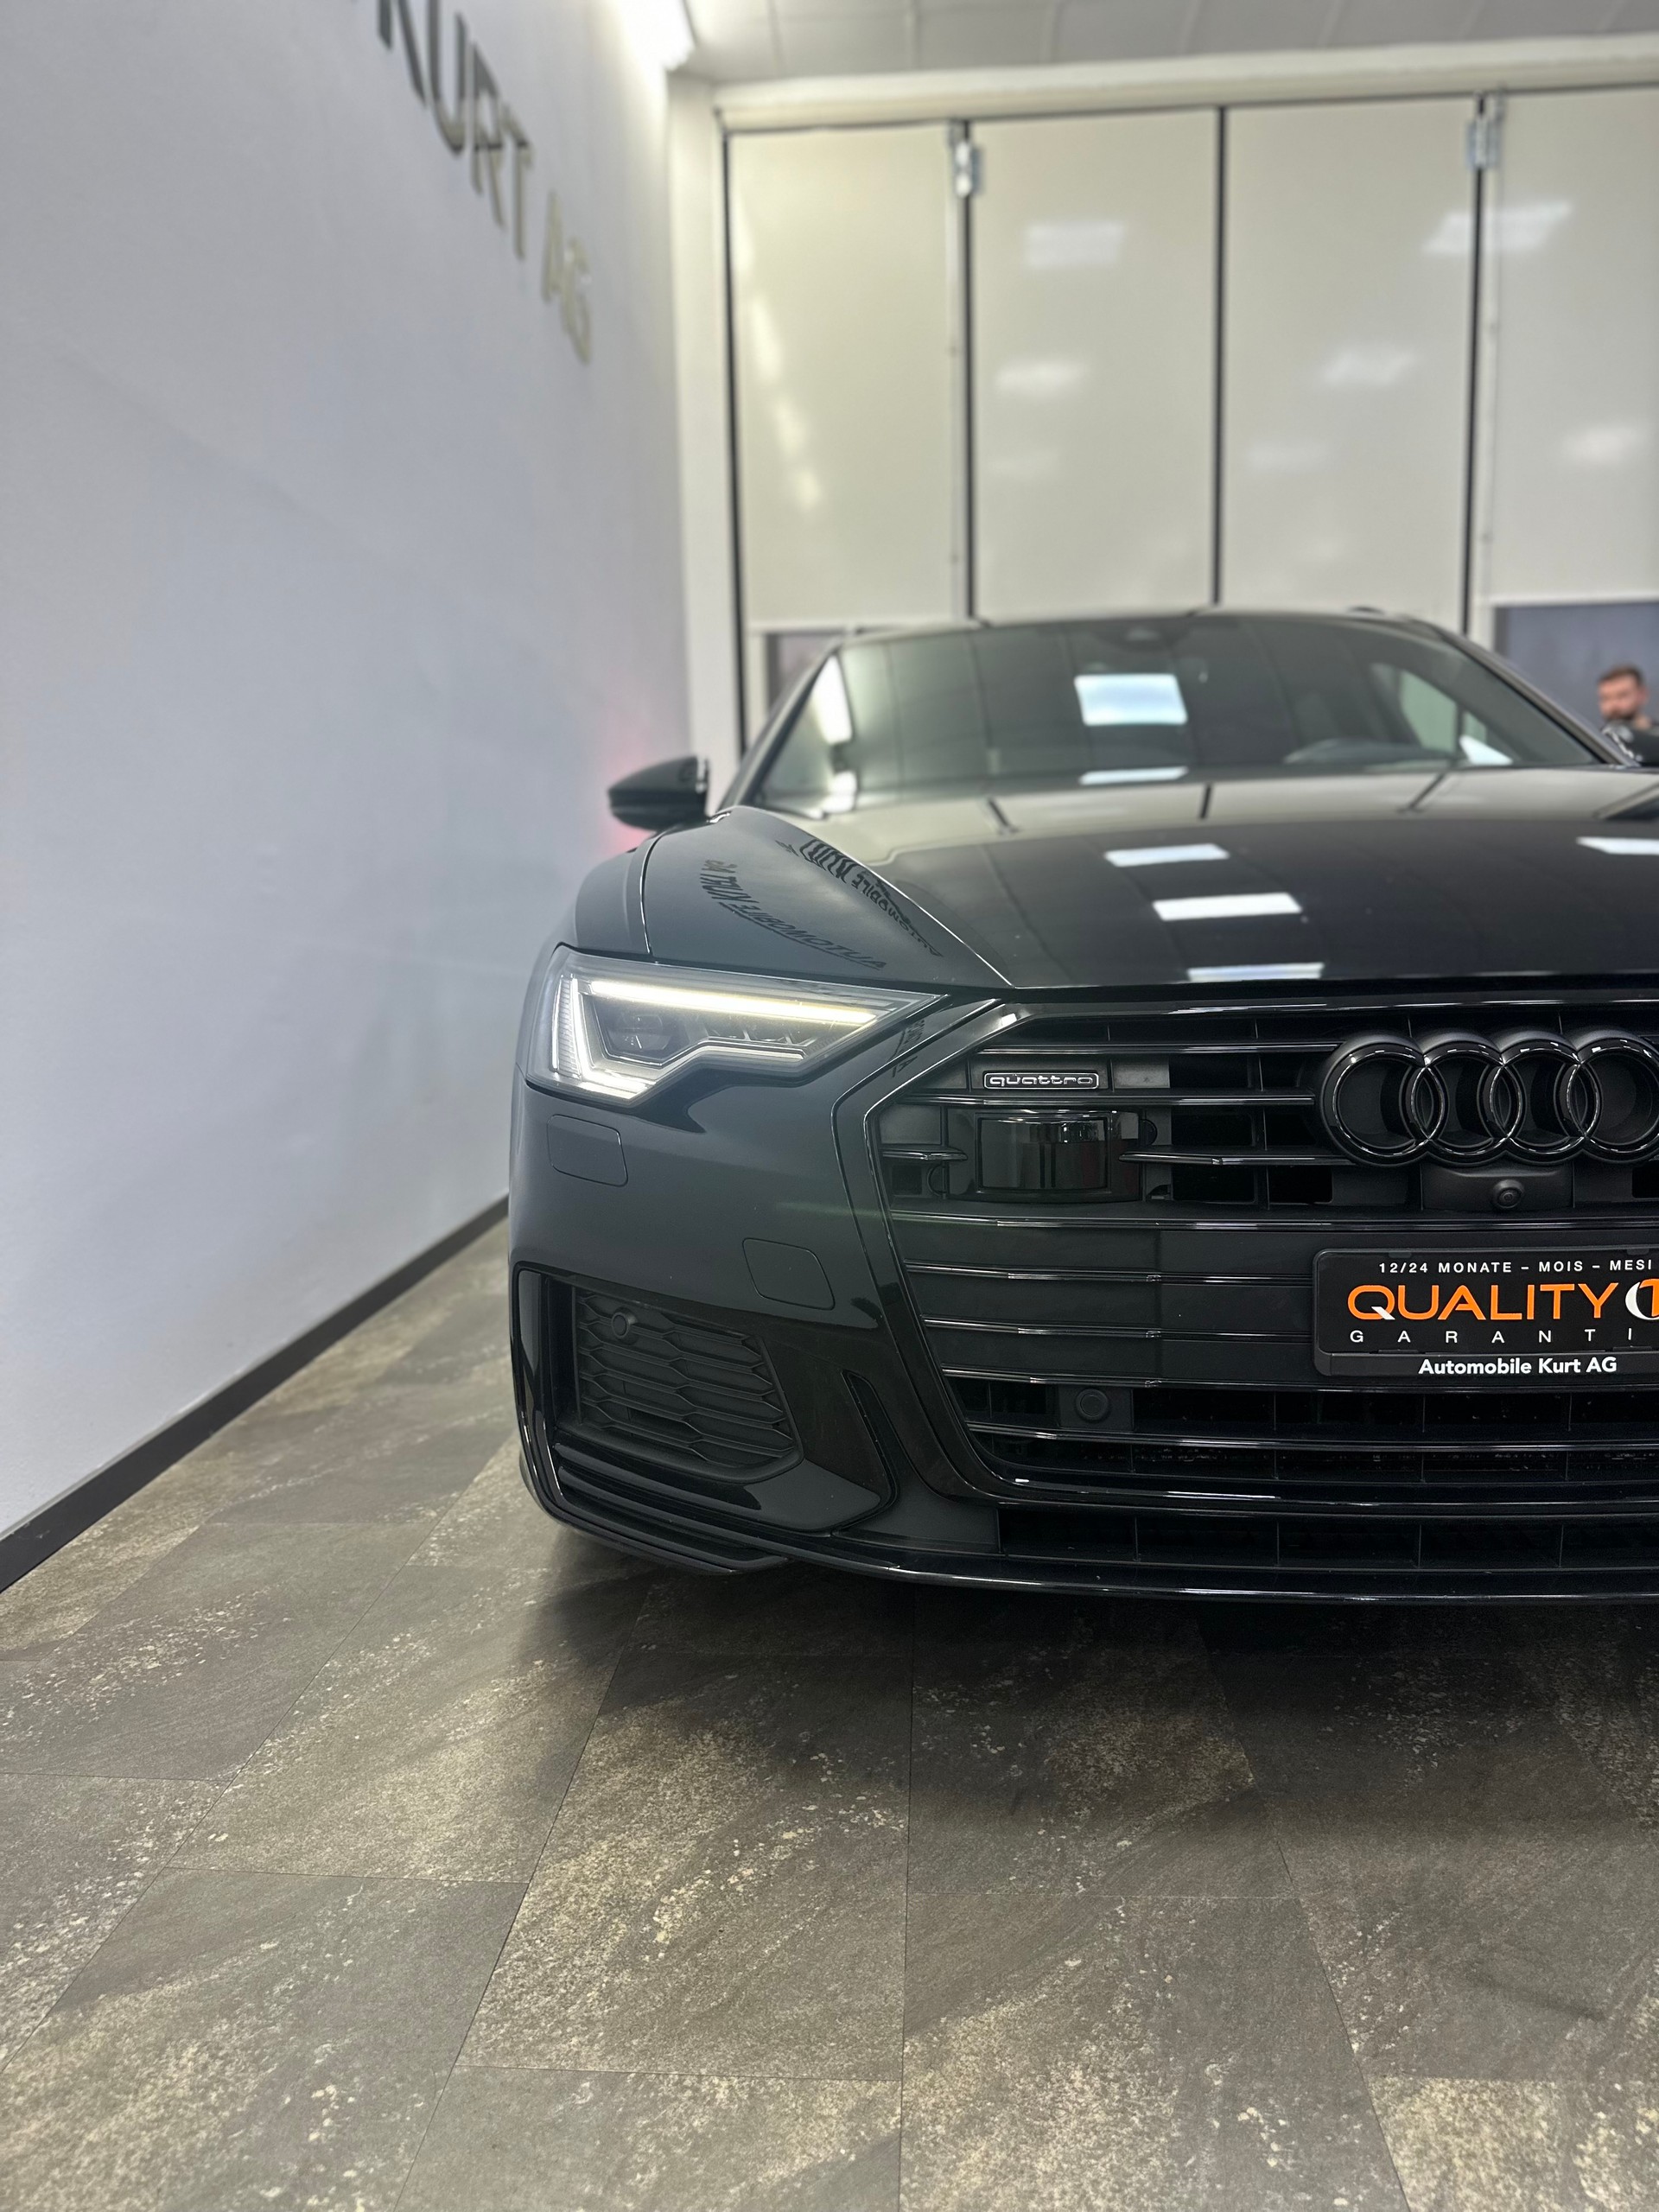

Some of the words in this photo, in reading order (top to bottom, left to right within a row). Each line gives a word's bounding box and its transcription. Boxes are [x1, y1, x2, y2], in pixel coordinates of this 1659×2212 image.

[989, 1075, 1093, 1087] quattro
[1379, 1262, 1429, 1274] 12/24
[1438, 1262, 1513, 1274] MONATE
[1538, 1261, 1584, 1273] MOIS
[1609, 1259, 1652, 1271] MESI
[1418, 1358, 1533, 1375] Automobile
[1538, 1358, 1581, 1374] Kurt
[1586, 1357, 1618, 1372] AG
